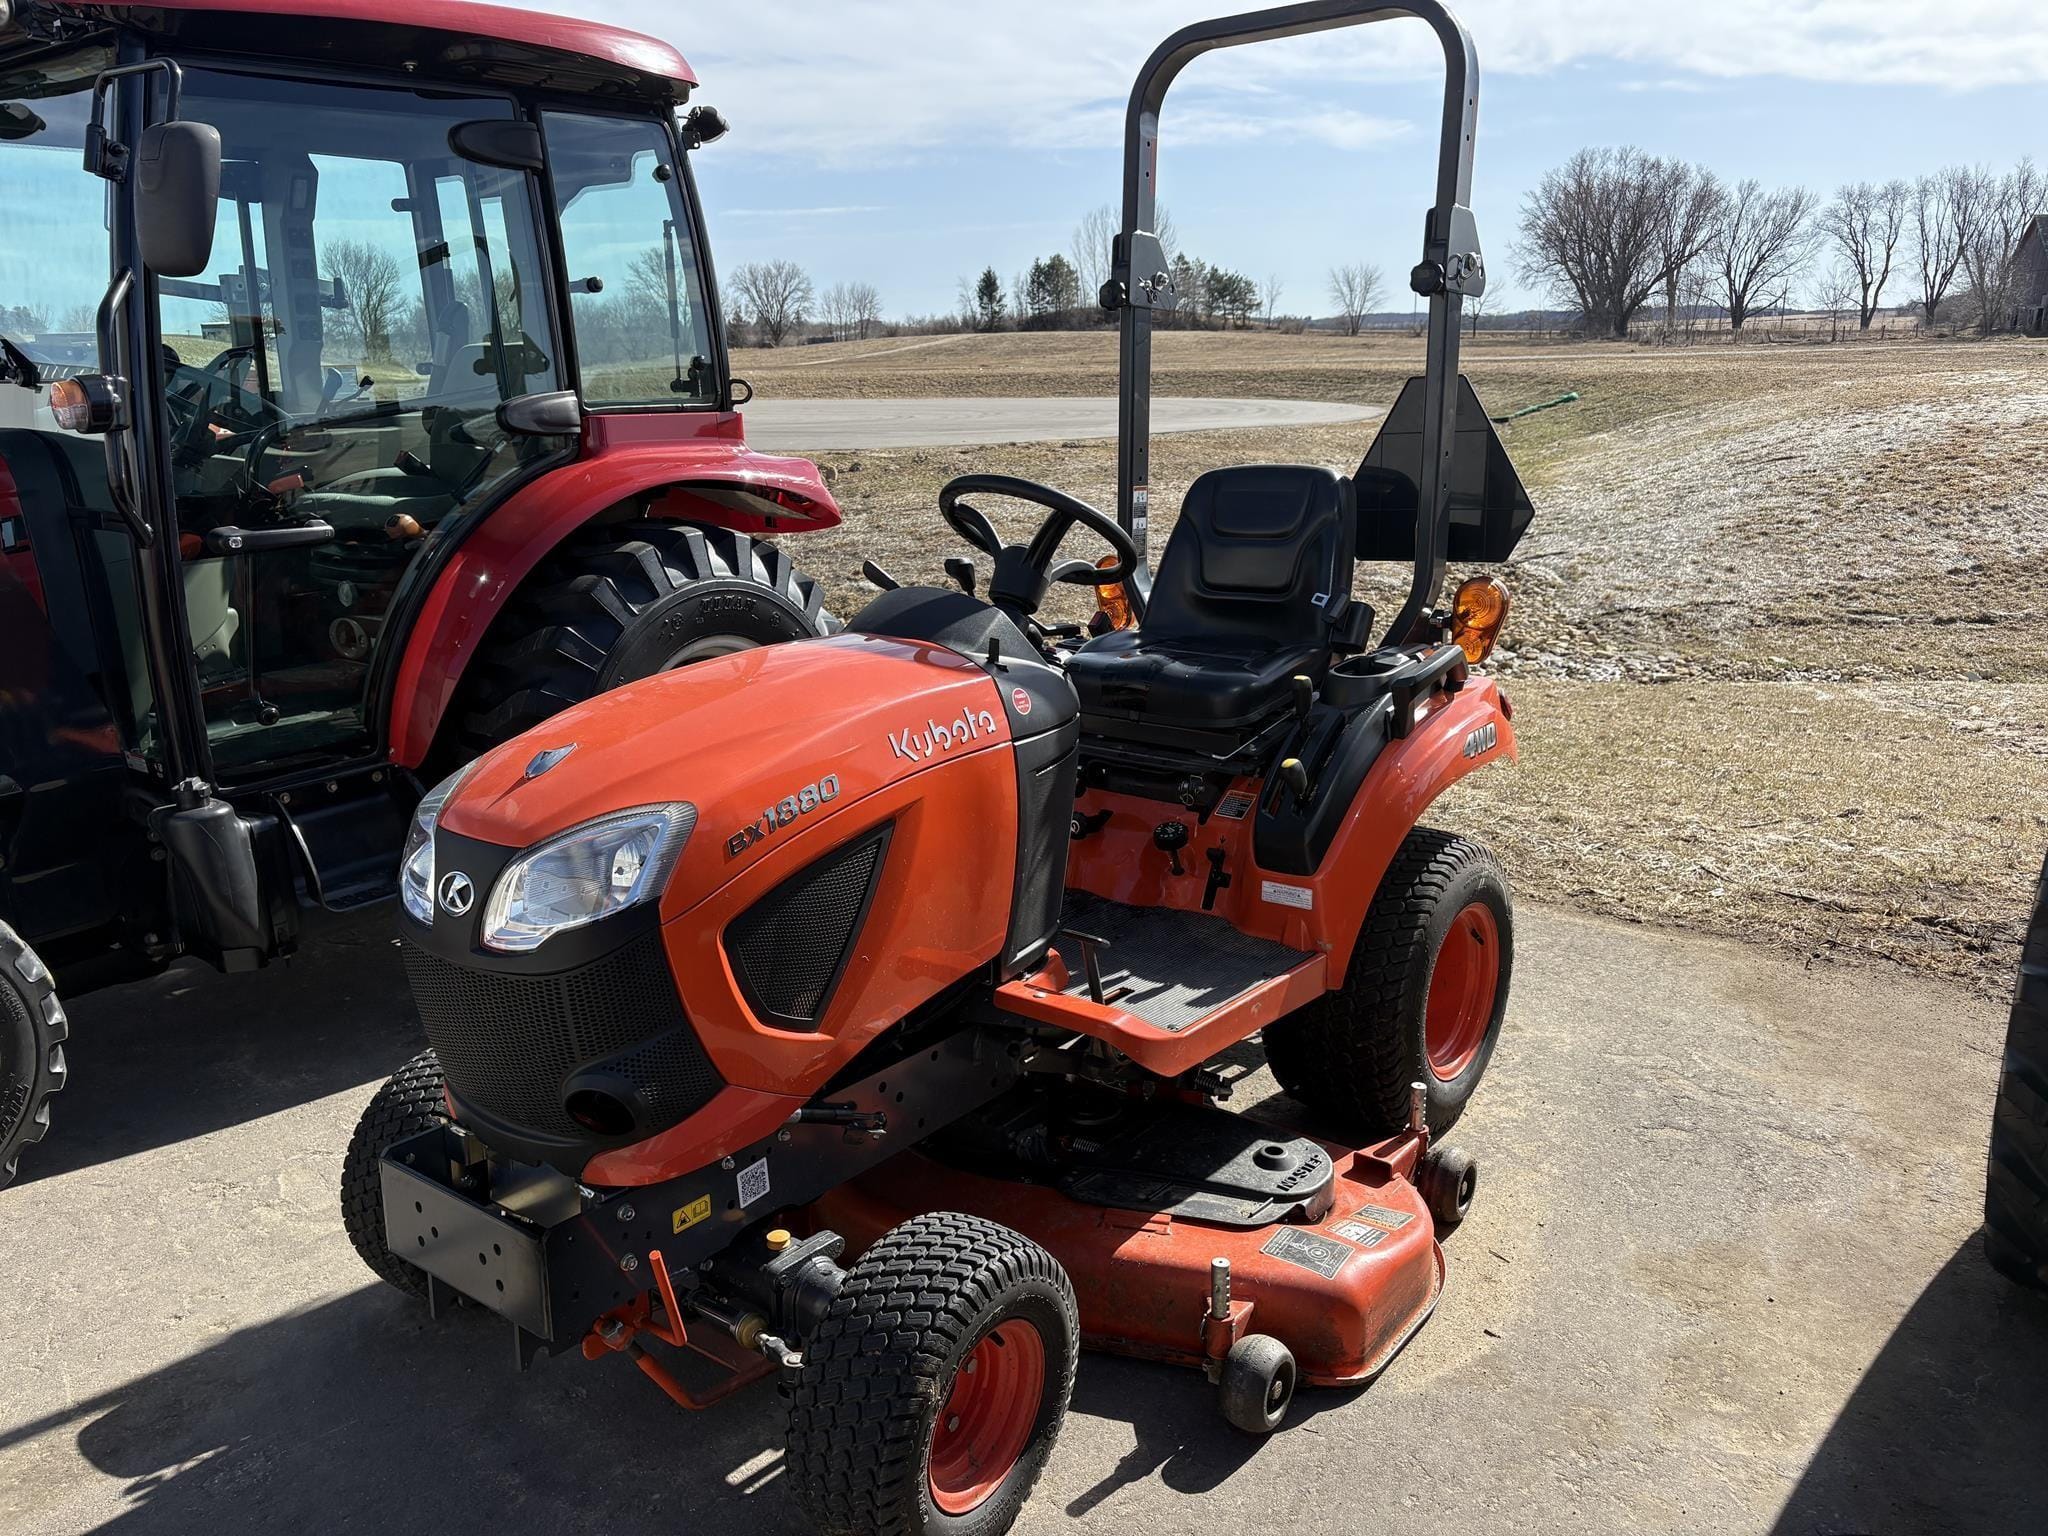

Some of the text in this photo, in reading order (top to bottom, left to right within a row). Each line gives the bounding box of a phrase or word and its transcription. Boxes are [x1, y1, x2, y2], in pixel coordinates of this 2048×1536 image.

[888, 706, 998, 762] Kubota
[1463, 720, 1497, 760] 4WD
[726, 773, 840, 857] BX1880
